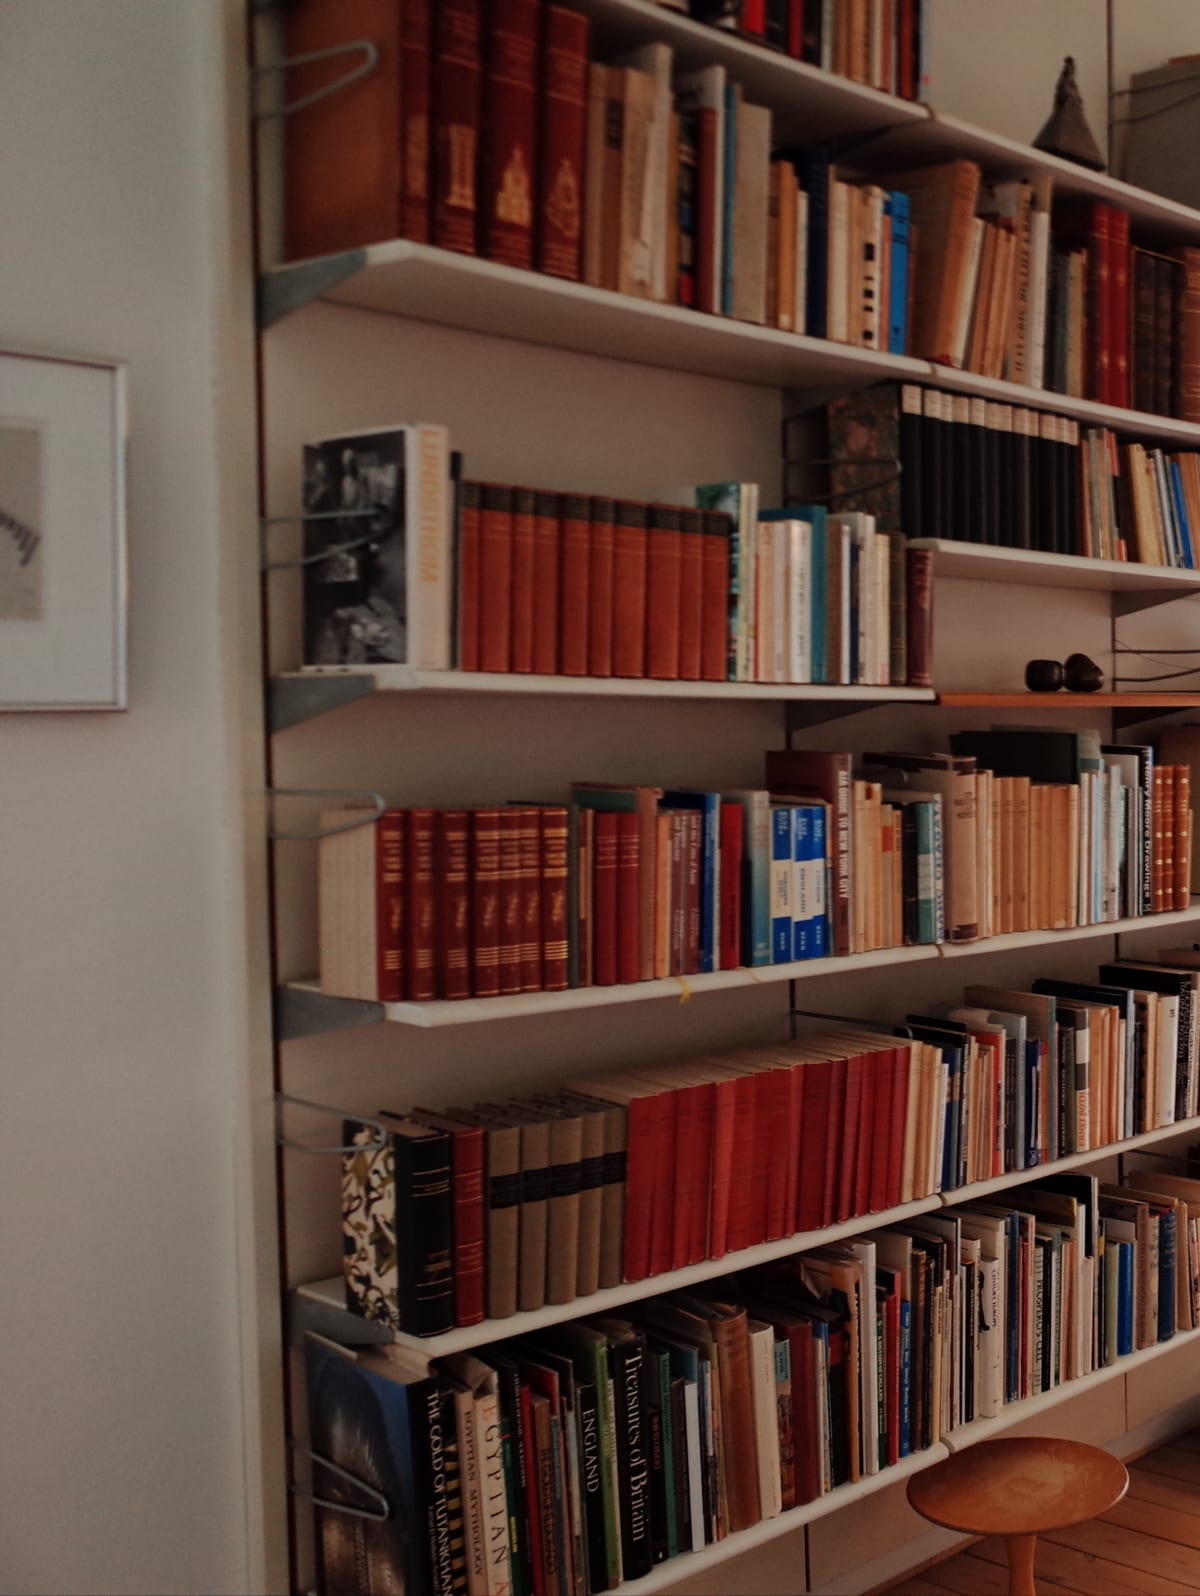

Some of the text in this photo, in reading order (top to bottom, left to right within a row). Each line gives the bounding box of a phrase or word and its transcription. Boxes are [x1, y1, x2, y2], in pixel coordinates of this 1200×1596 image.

[839, 789, 848, 814] GUIDE
[839, 831, 848, 852] NEW
[1143, 761, 1152, 898] Henry Moore Drawings
[839, 854, 848, 877] YORK
[839, 879, 848, 899] CITY
[1035, 1279, 1045, 1363] PROSPERO'S CELL
[426, 1389, 441, 1424] THE
[428, 1426, 444, 1471] GOLD
[581, 1408, 600, 1493] ENGLAND
[624, 1347, 649, 1543] Treasures of Britain
[433, 1473, 447, 1493] OF
[464, 1411, 483, 1576] EGYPTIAN MYTHOLOGY
[483, 1404, 508, 1564] EGYPTIAN
